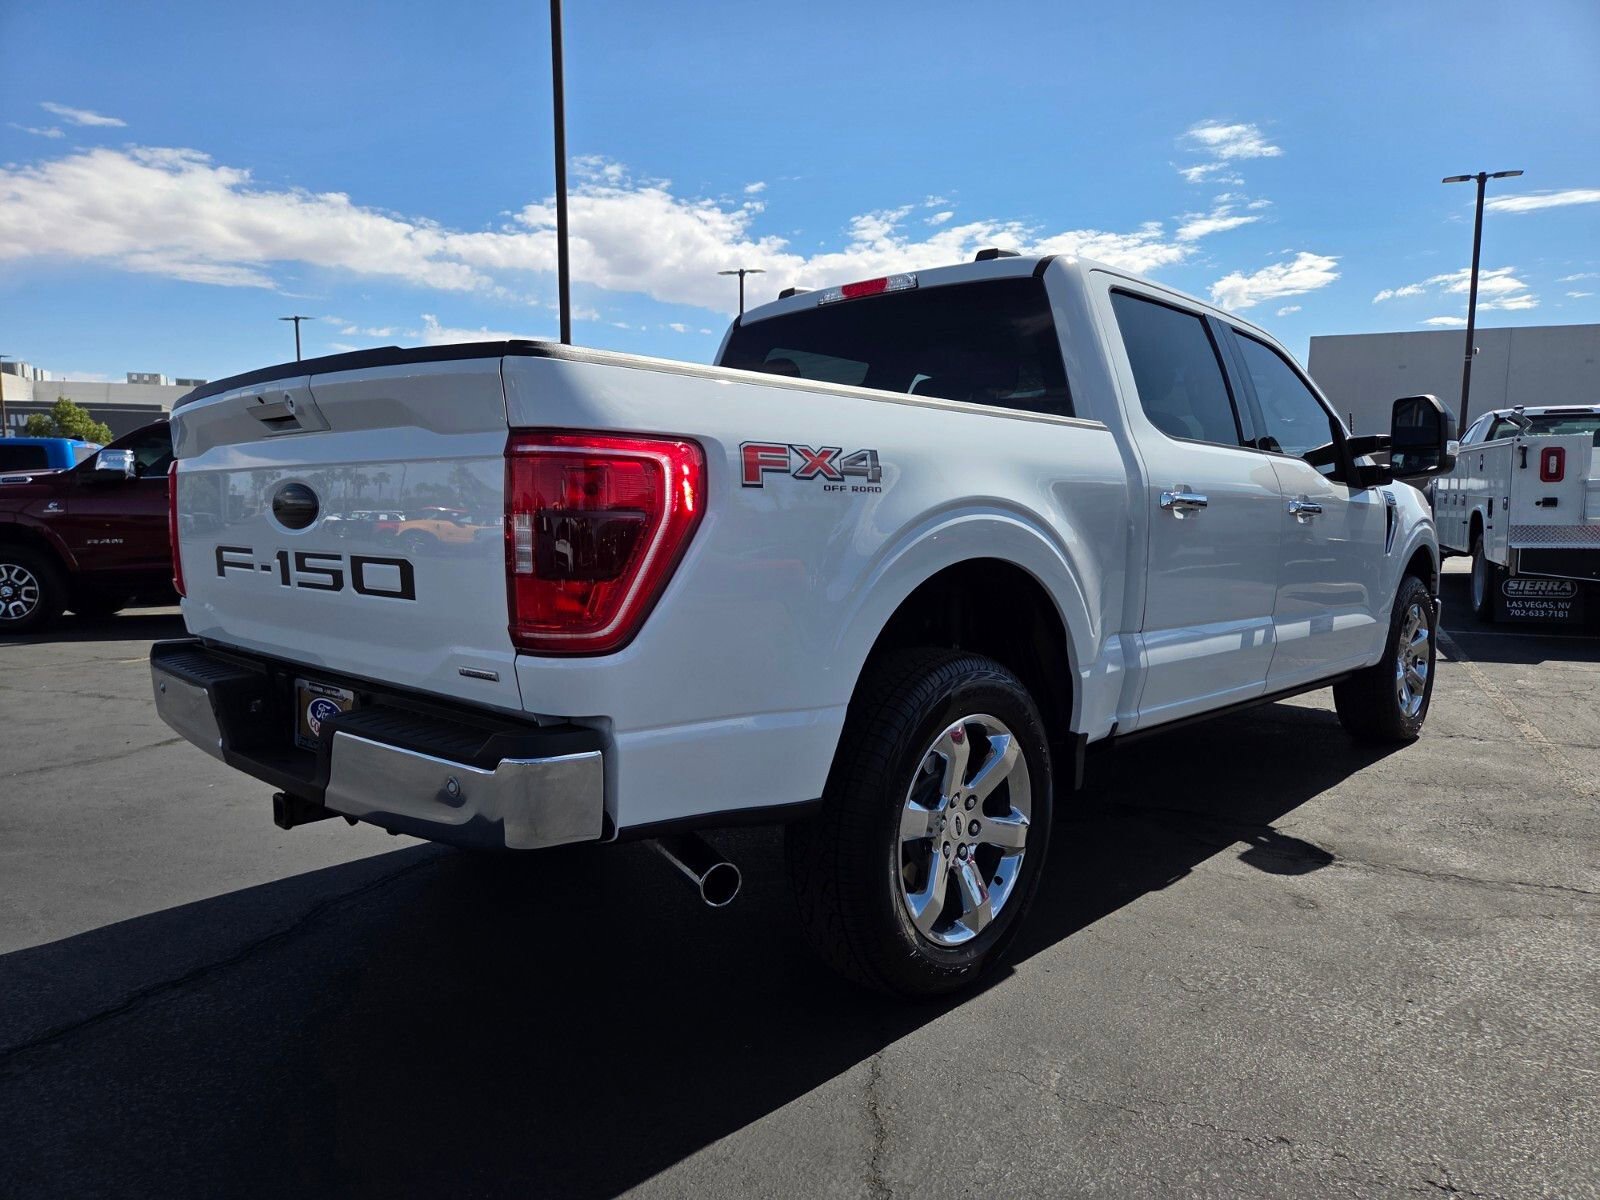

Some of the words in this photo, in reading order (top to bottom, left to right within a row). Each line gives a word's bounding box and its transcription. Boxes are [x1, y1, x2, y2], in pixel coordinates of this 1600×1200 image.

[739, 441, 882, 488] FX4
[215, 545, 417, 601] F-150
[1507, 580, 1572, 591] SIERRA
[1524, 601, 1556, 609] VEGAS,
[1509, 609, 1569, 618] 702-633-7181
